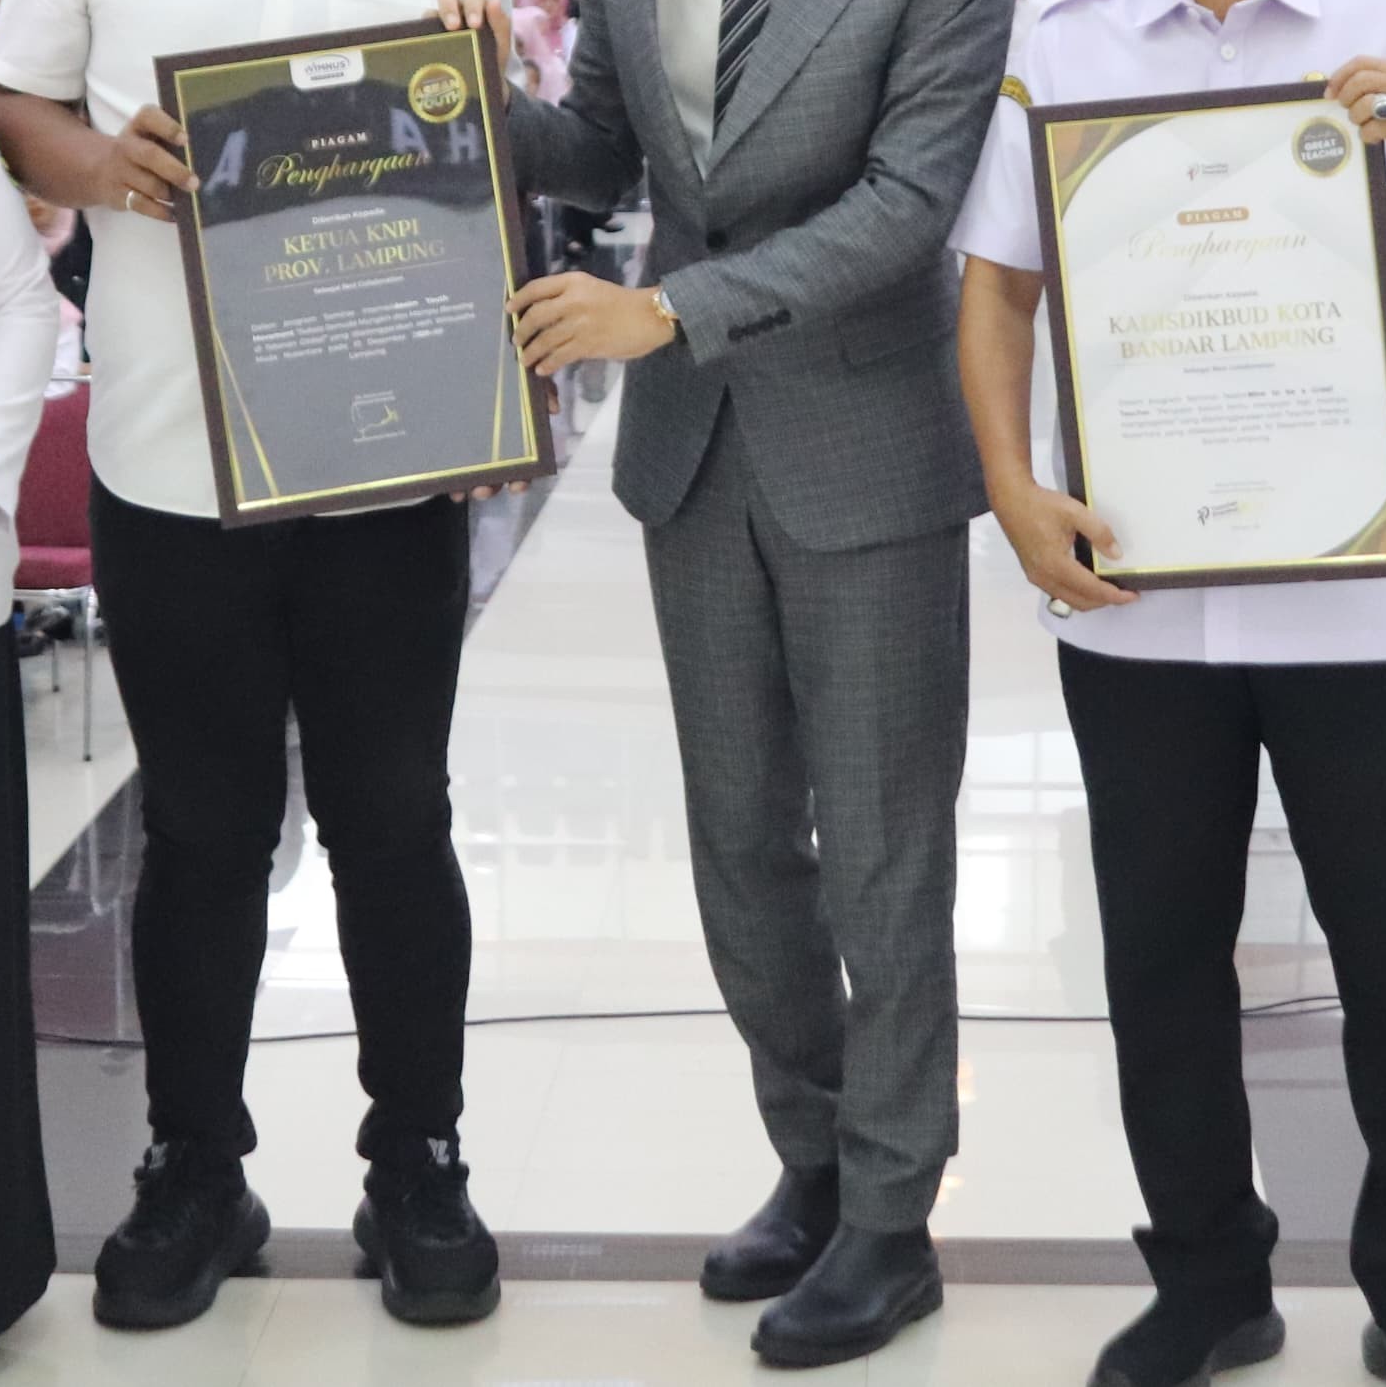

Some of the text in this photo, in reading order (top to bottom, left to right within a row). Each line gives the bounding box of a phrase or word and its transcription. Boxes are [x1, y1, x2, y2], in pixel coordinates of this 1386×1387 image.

[311, 131, 367, 149] PIAGAM
[1300, 147, 1345, 162] TEACHER
[1304, 138, 1336, 151] GREAT
[256, 151, 432, 195] Penghargaan
[1186, 209, 1244, 223] PIAGAM
[283, 217, 421, 255] KETUA KNPI
[263, 239, 445, 283] PROV. LAMPUNG
[1108, 300, 1343, 335] KADISDIKBUD KOTA
[1120, 327, 1336, 360] BANDAR LAMPUNG
